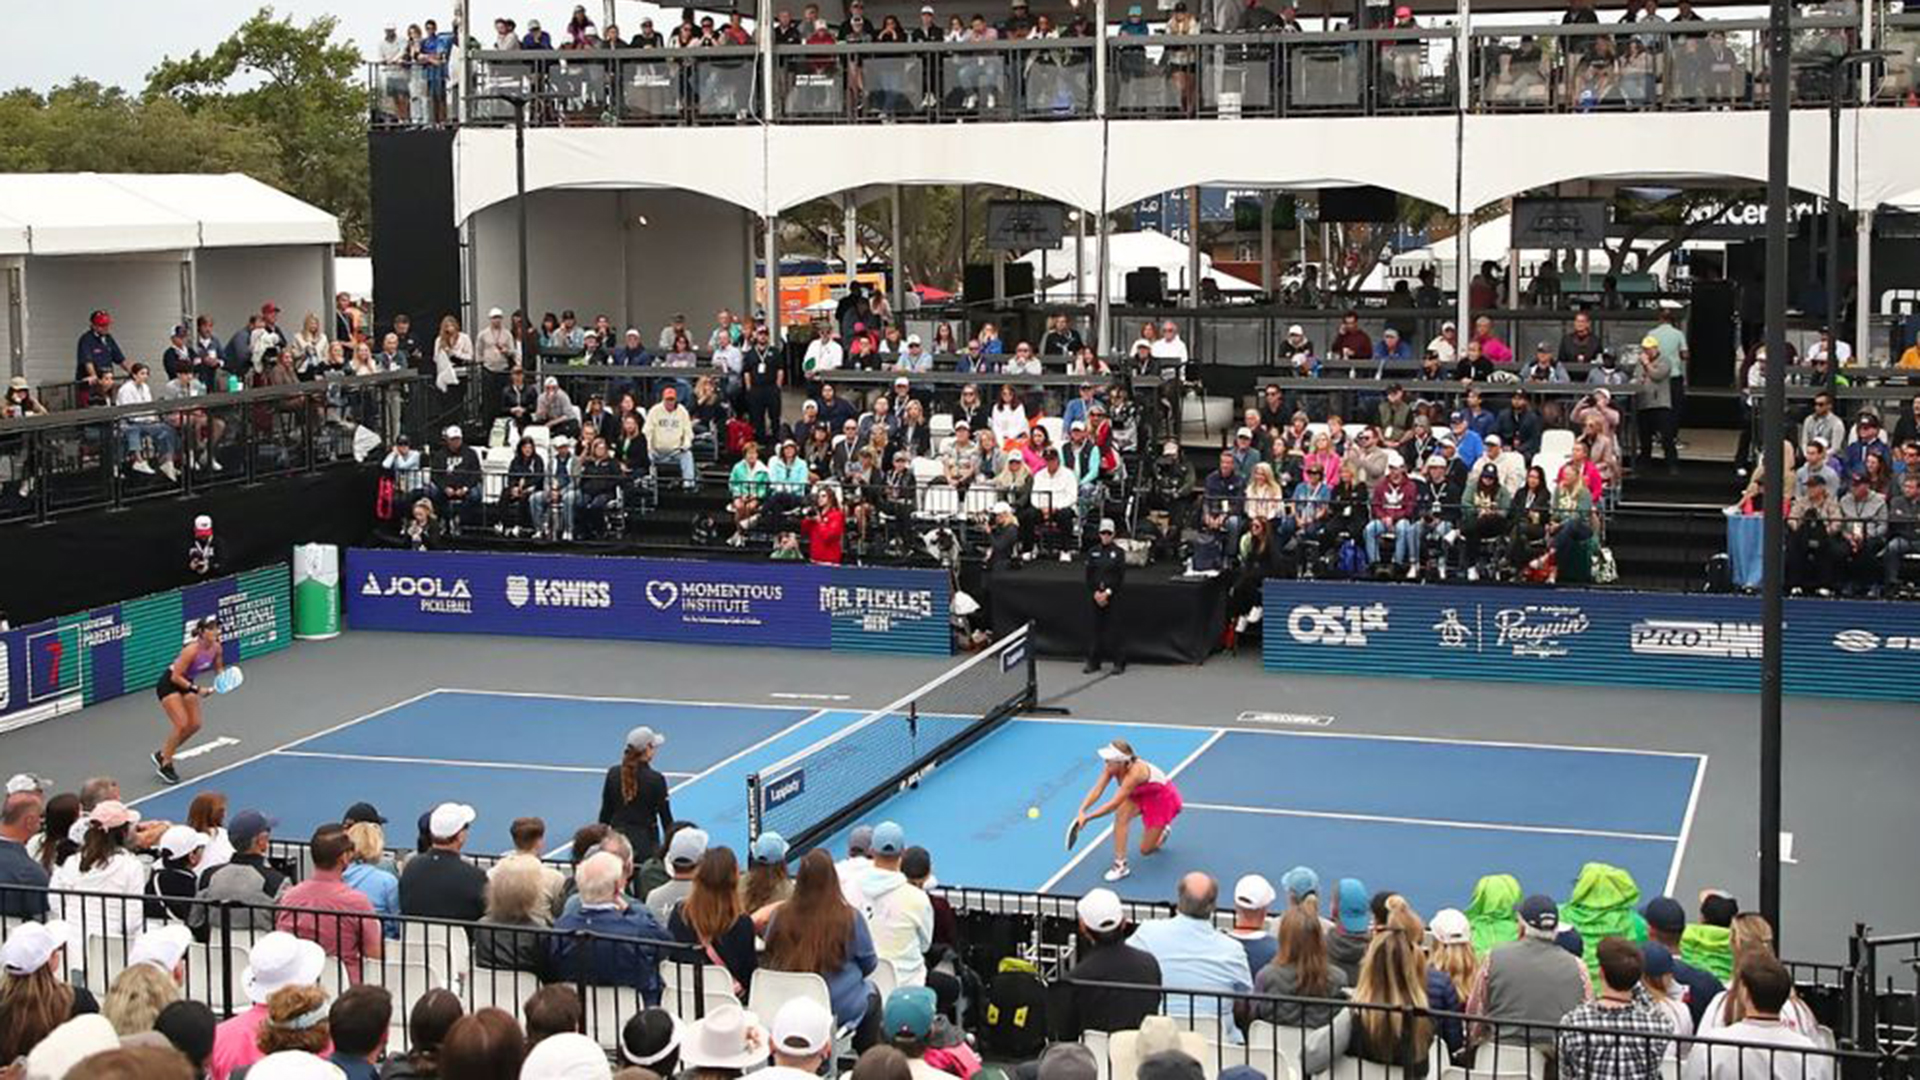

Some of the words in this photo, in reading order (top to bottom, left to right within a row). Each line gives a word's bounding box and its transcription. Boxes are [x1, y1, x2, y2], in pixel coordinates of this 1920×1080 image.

[384, 577, 472, 598] JOOLA
[681, 582, 783, 600] MOMENTOUS
[420, 599, 472, 613] PICKLEBALL
[681, 598, 750, 613] INSTITUTE
[855, 587, 932, 617] PICKLES
[1494, 609, 1590, 647] Penguin
[44, 642, 62, 687] 7
